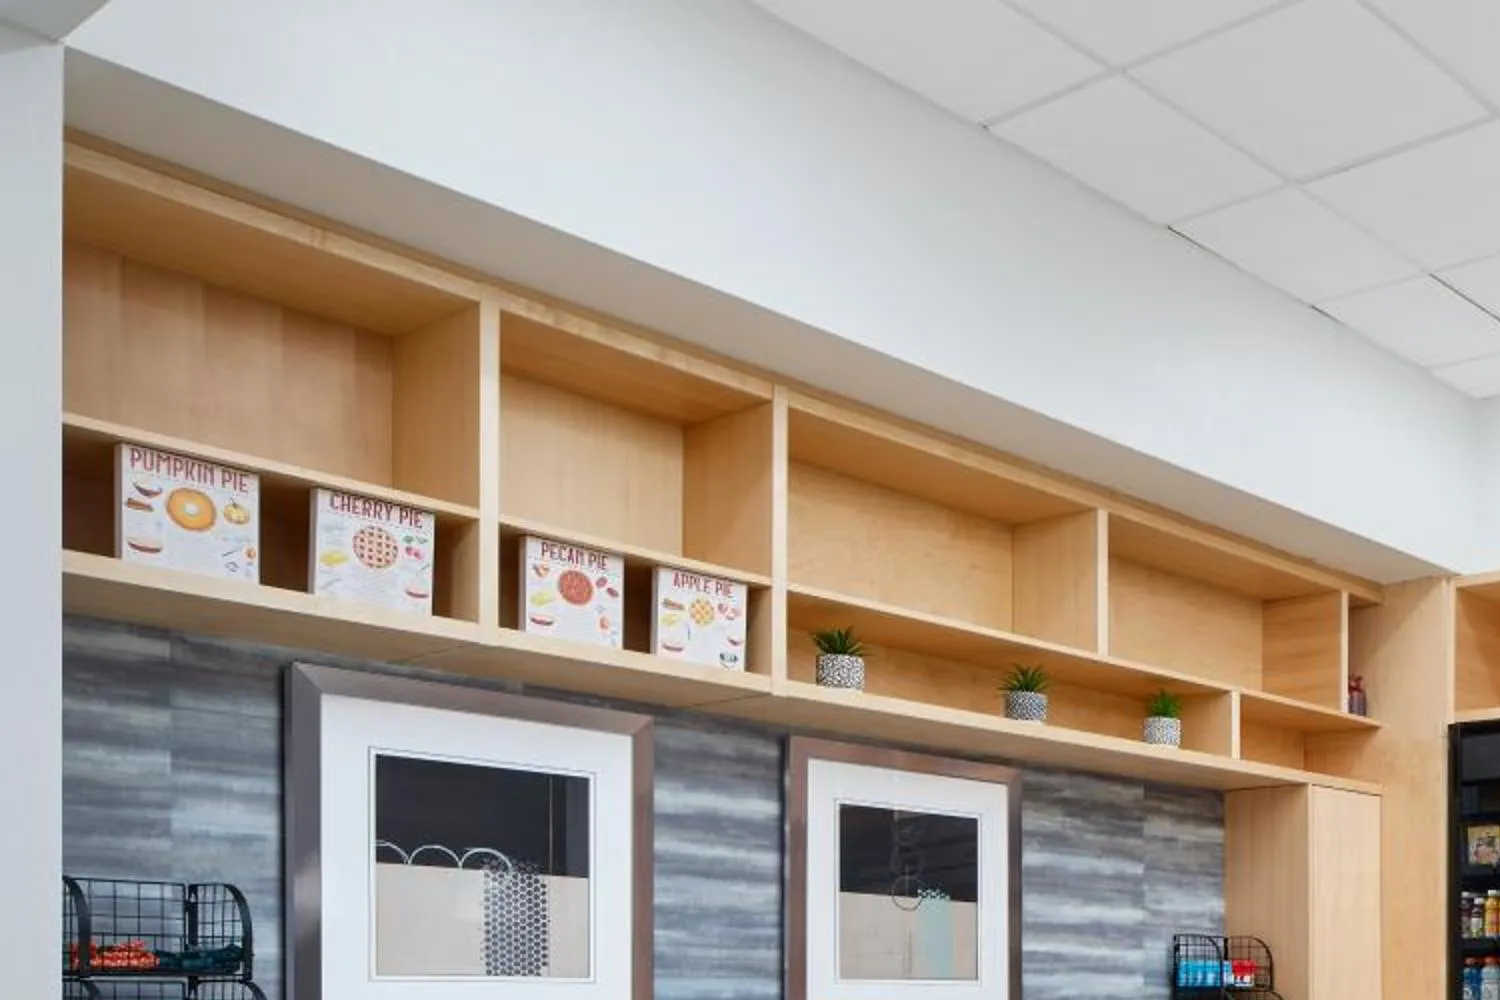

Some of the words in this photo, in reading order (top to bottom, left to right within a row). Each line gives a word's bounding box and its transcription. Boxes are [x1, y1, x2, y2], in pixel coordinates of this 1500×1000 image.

[129, 448, 215, 485] PUMPKIN
[221, 468, 249, 493] PIE
[330, 492, 392, 523] CHERRY
[399, 507, 423, 529] PIE
[541, 542, 586, 567] PECAN
[588, 552, 609, 570] PIE
[672, 570, 711, 594] APPLE
[715, 582, 734, 597] PIE
